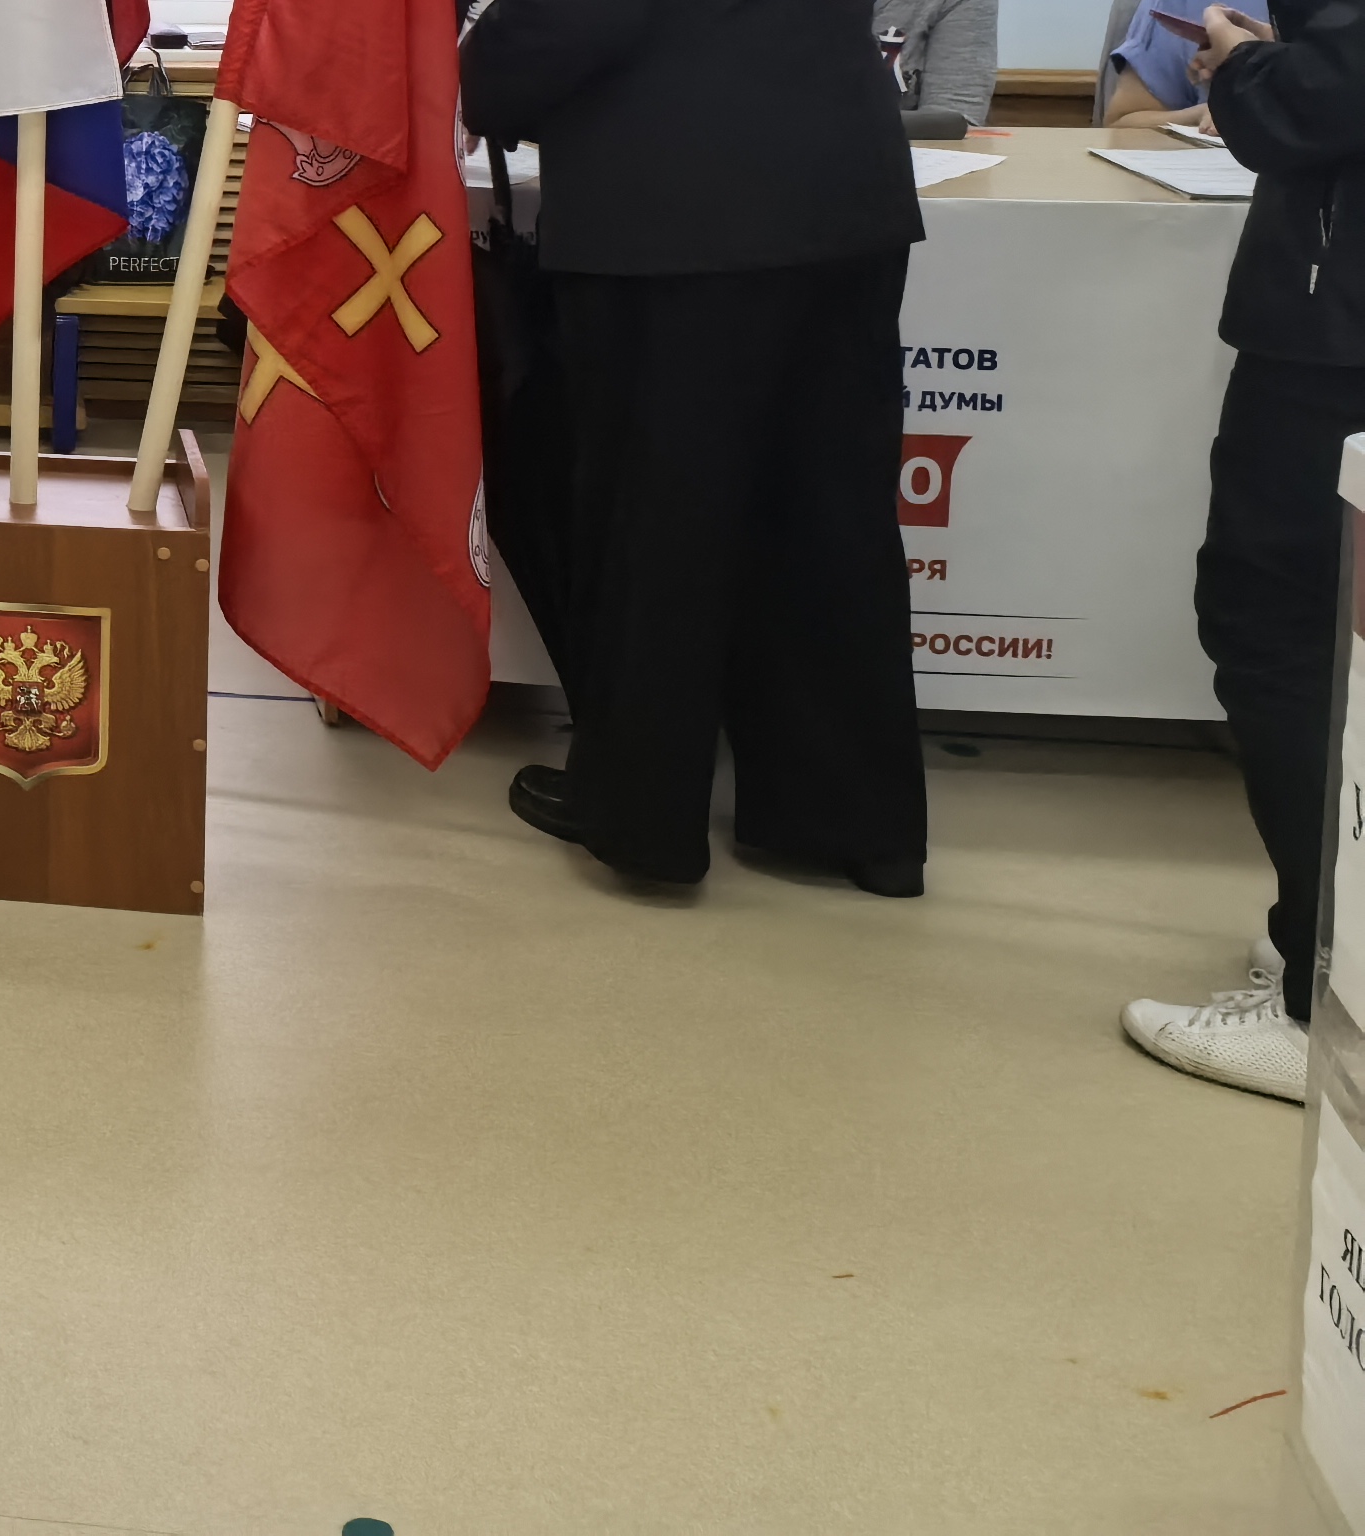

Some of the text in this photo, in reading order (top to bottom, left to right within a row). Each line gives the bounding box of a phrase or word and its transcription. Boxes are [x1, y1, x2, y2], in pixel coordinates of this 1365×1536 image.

[900, 346, 998, 371] ТАТОВ
[917, 390, 1003, 412] ДУМЫ
[899, 456, 943, 505] 0
[907, 558, 947, 581] РЯ
[911, 632, 1054, 659] РОССИИ!
